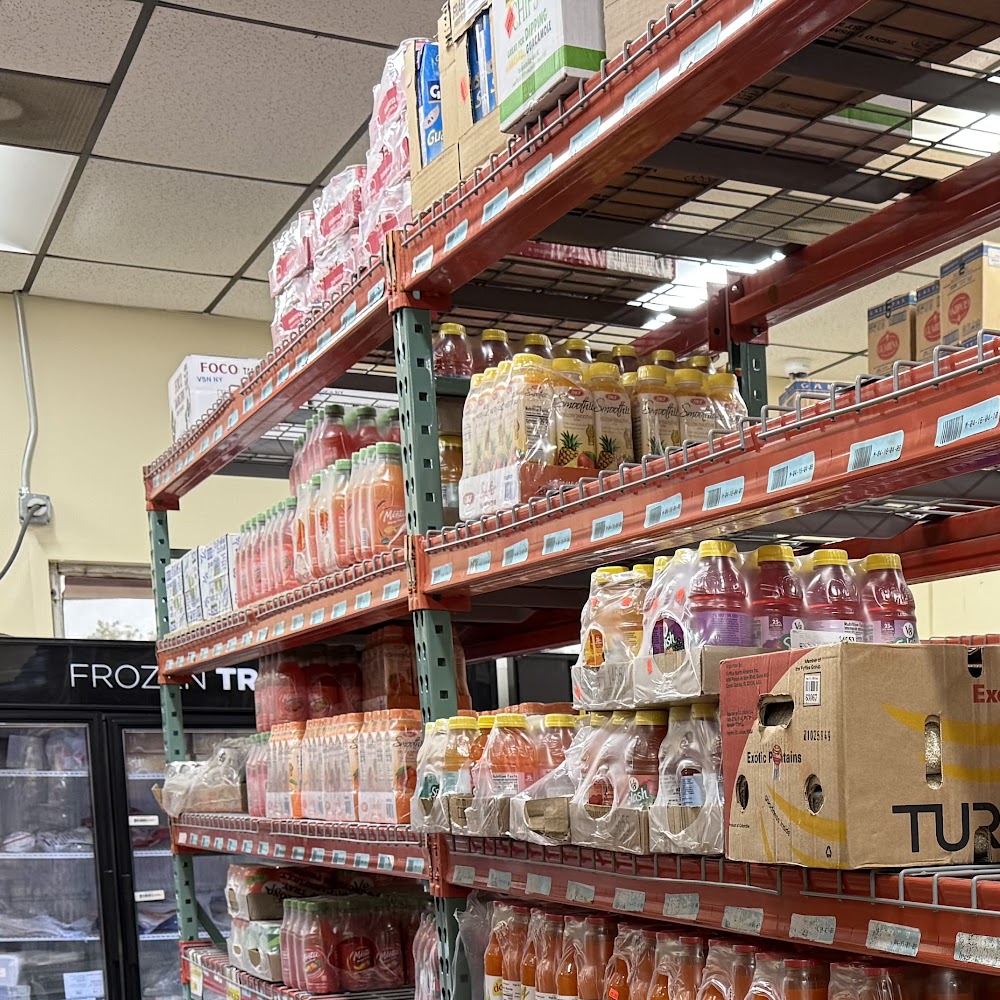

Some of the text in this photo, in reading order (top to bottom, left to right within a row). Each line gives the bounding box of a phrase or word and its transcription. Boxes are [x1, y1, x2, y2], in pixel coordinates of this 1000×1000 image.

[200, 362, 238, 375] FOCO
[70, 663, 206, 690] FROZN
[747, 751, 767, 764] Exotic
